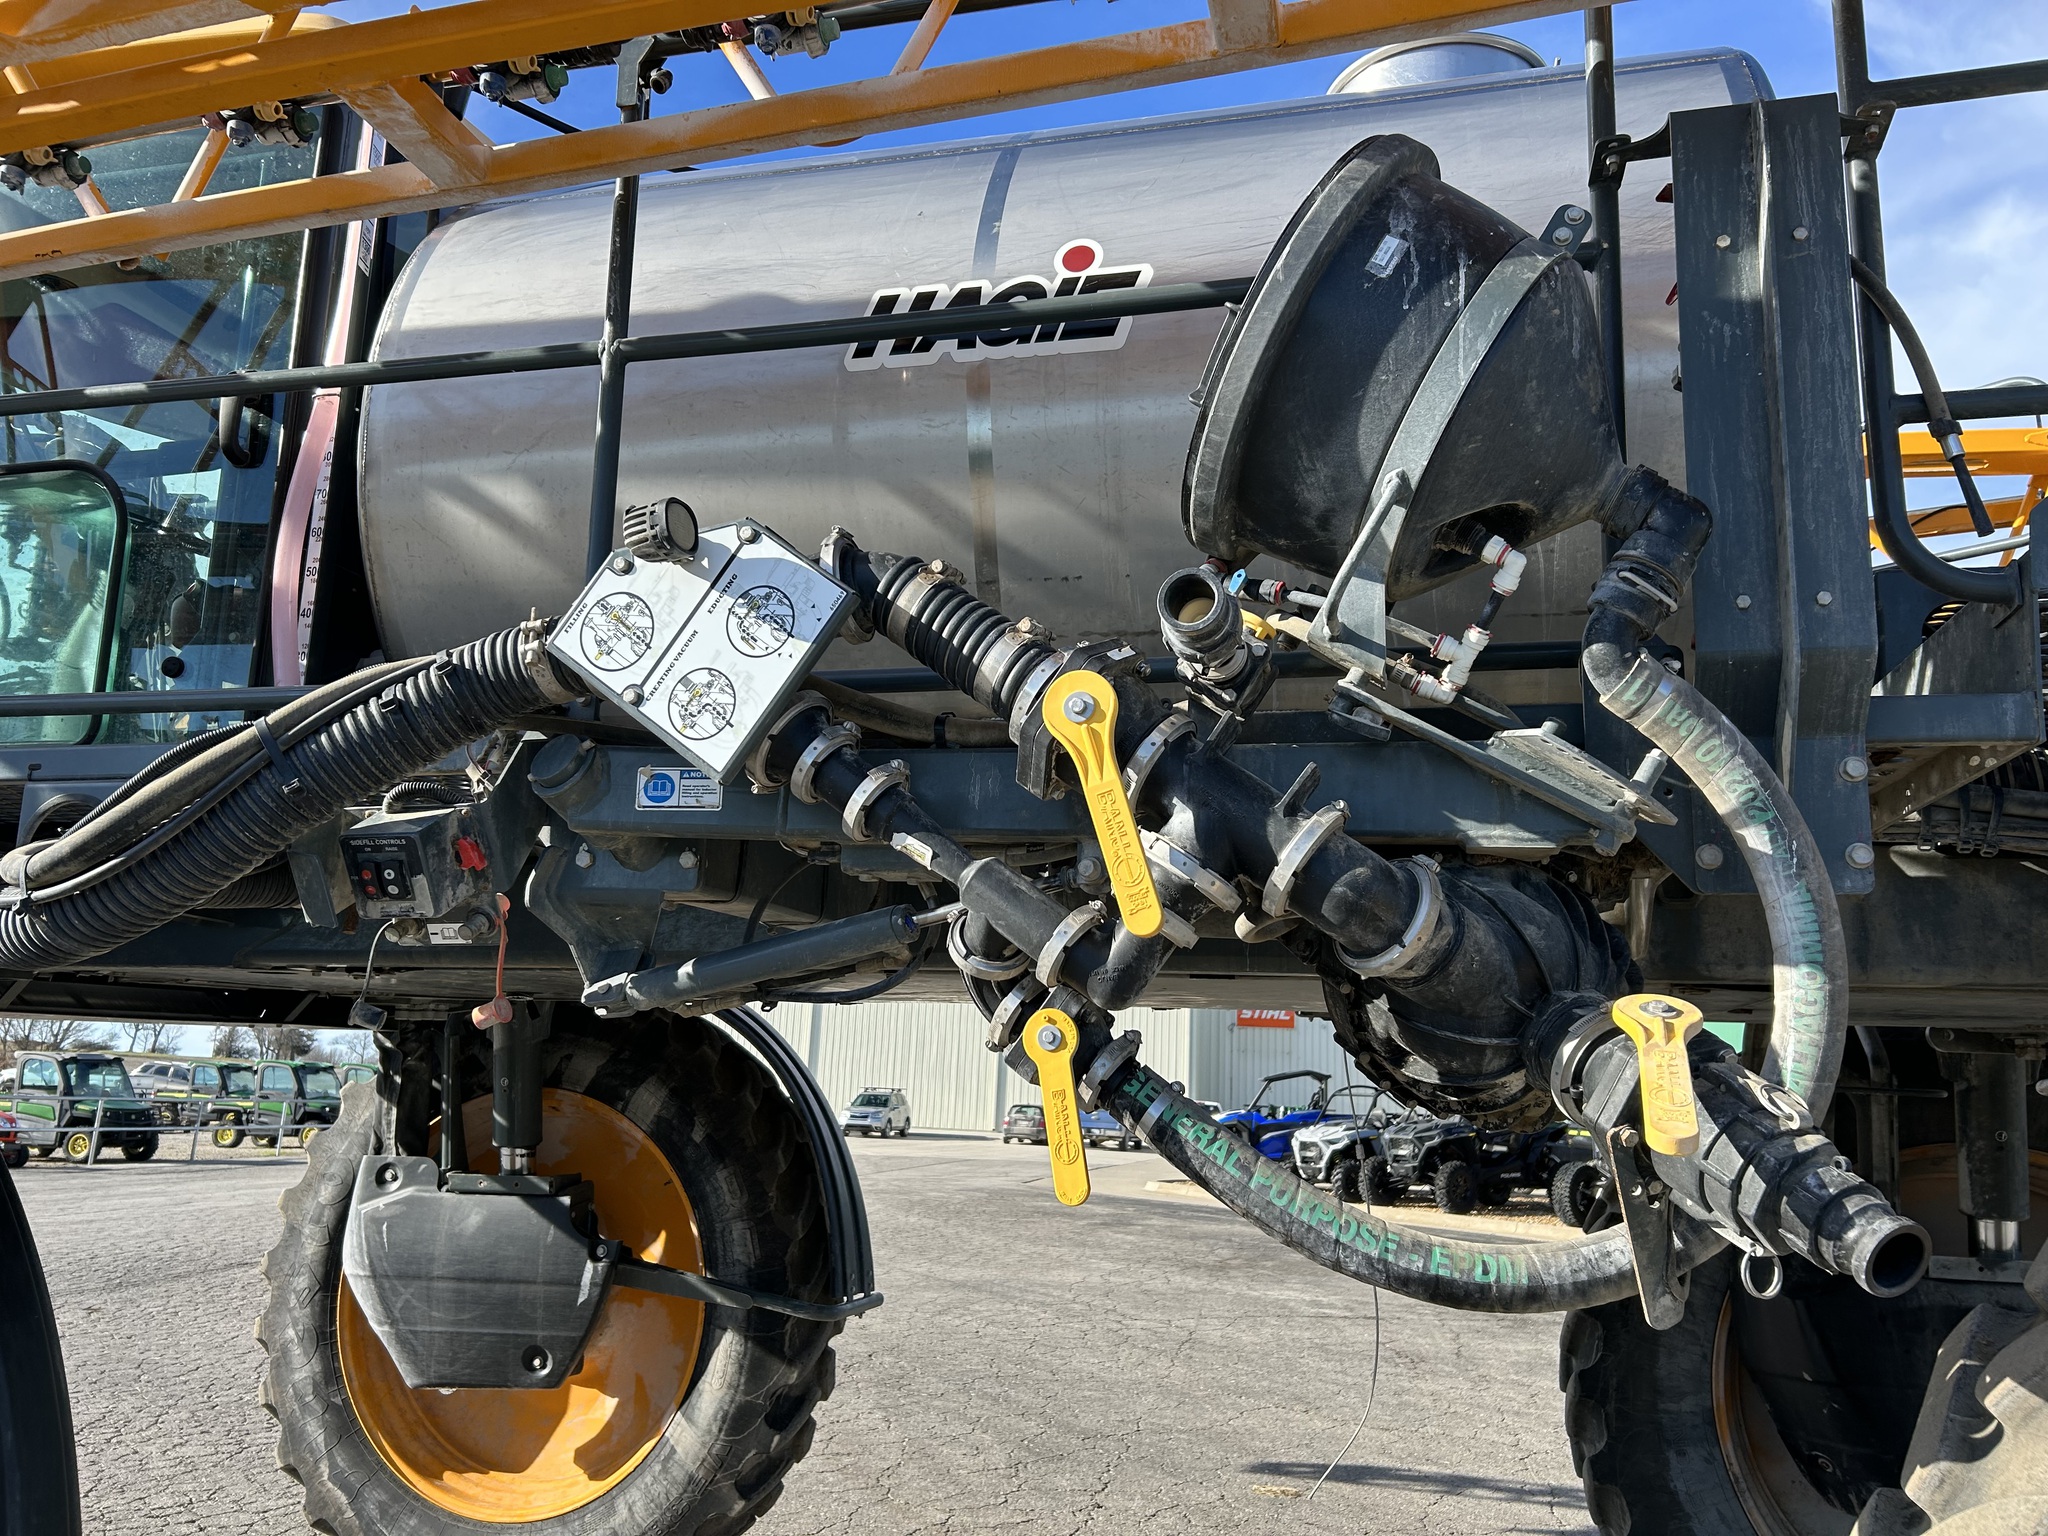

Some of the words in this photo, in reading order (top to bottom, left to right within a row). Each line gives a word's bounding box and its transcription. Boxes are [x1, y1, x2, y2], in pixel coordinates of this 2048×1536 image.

[707, 573, 738, 615] EDUCTING
[564, 602, 588, 634] FILLING
[645, 661, 676, 702] CREATING
[674, 629, 699, 662] VACUUM
[350, 838, 375, 846] SIDEFILL
[375, 838, 406, 846] CONTROLS
[1250, 1166, 1400, 1262] PURPOSE
[1429, 1245, 1529, 1285] EPDM
